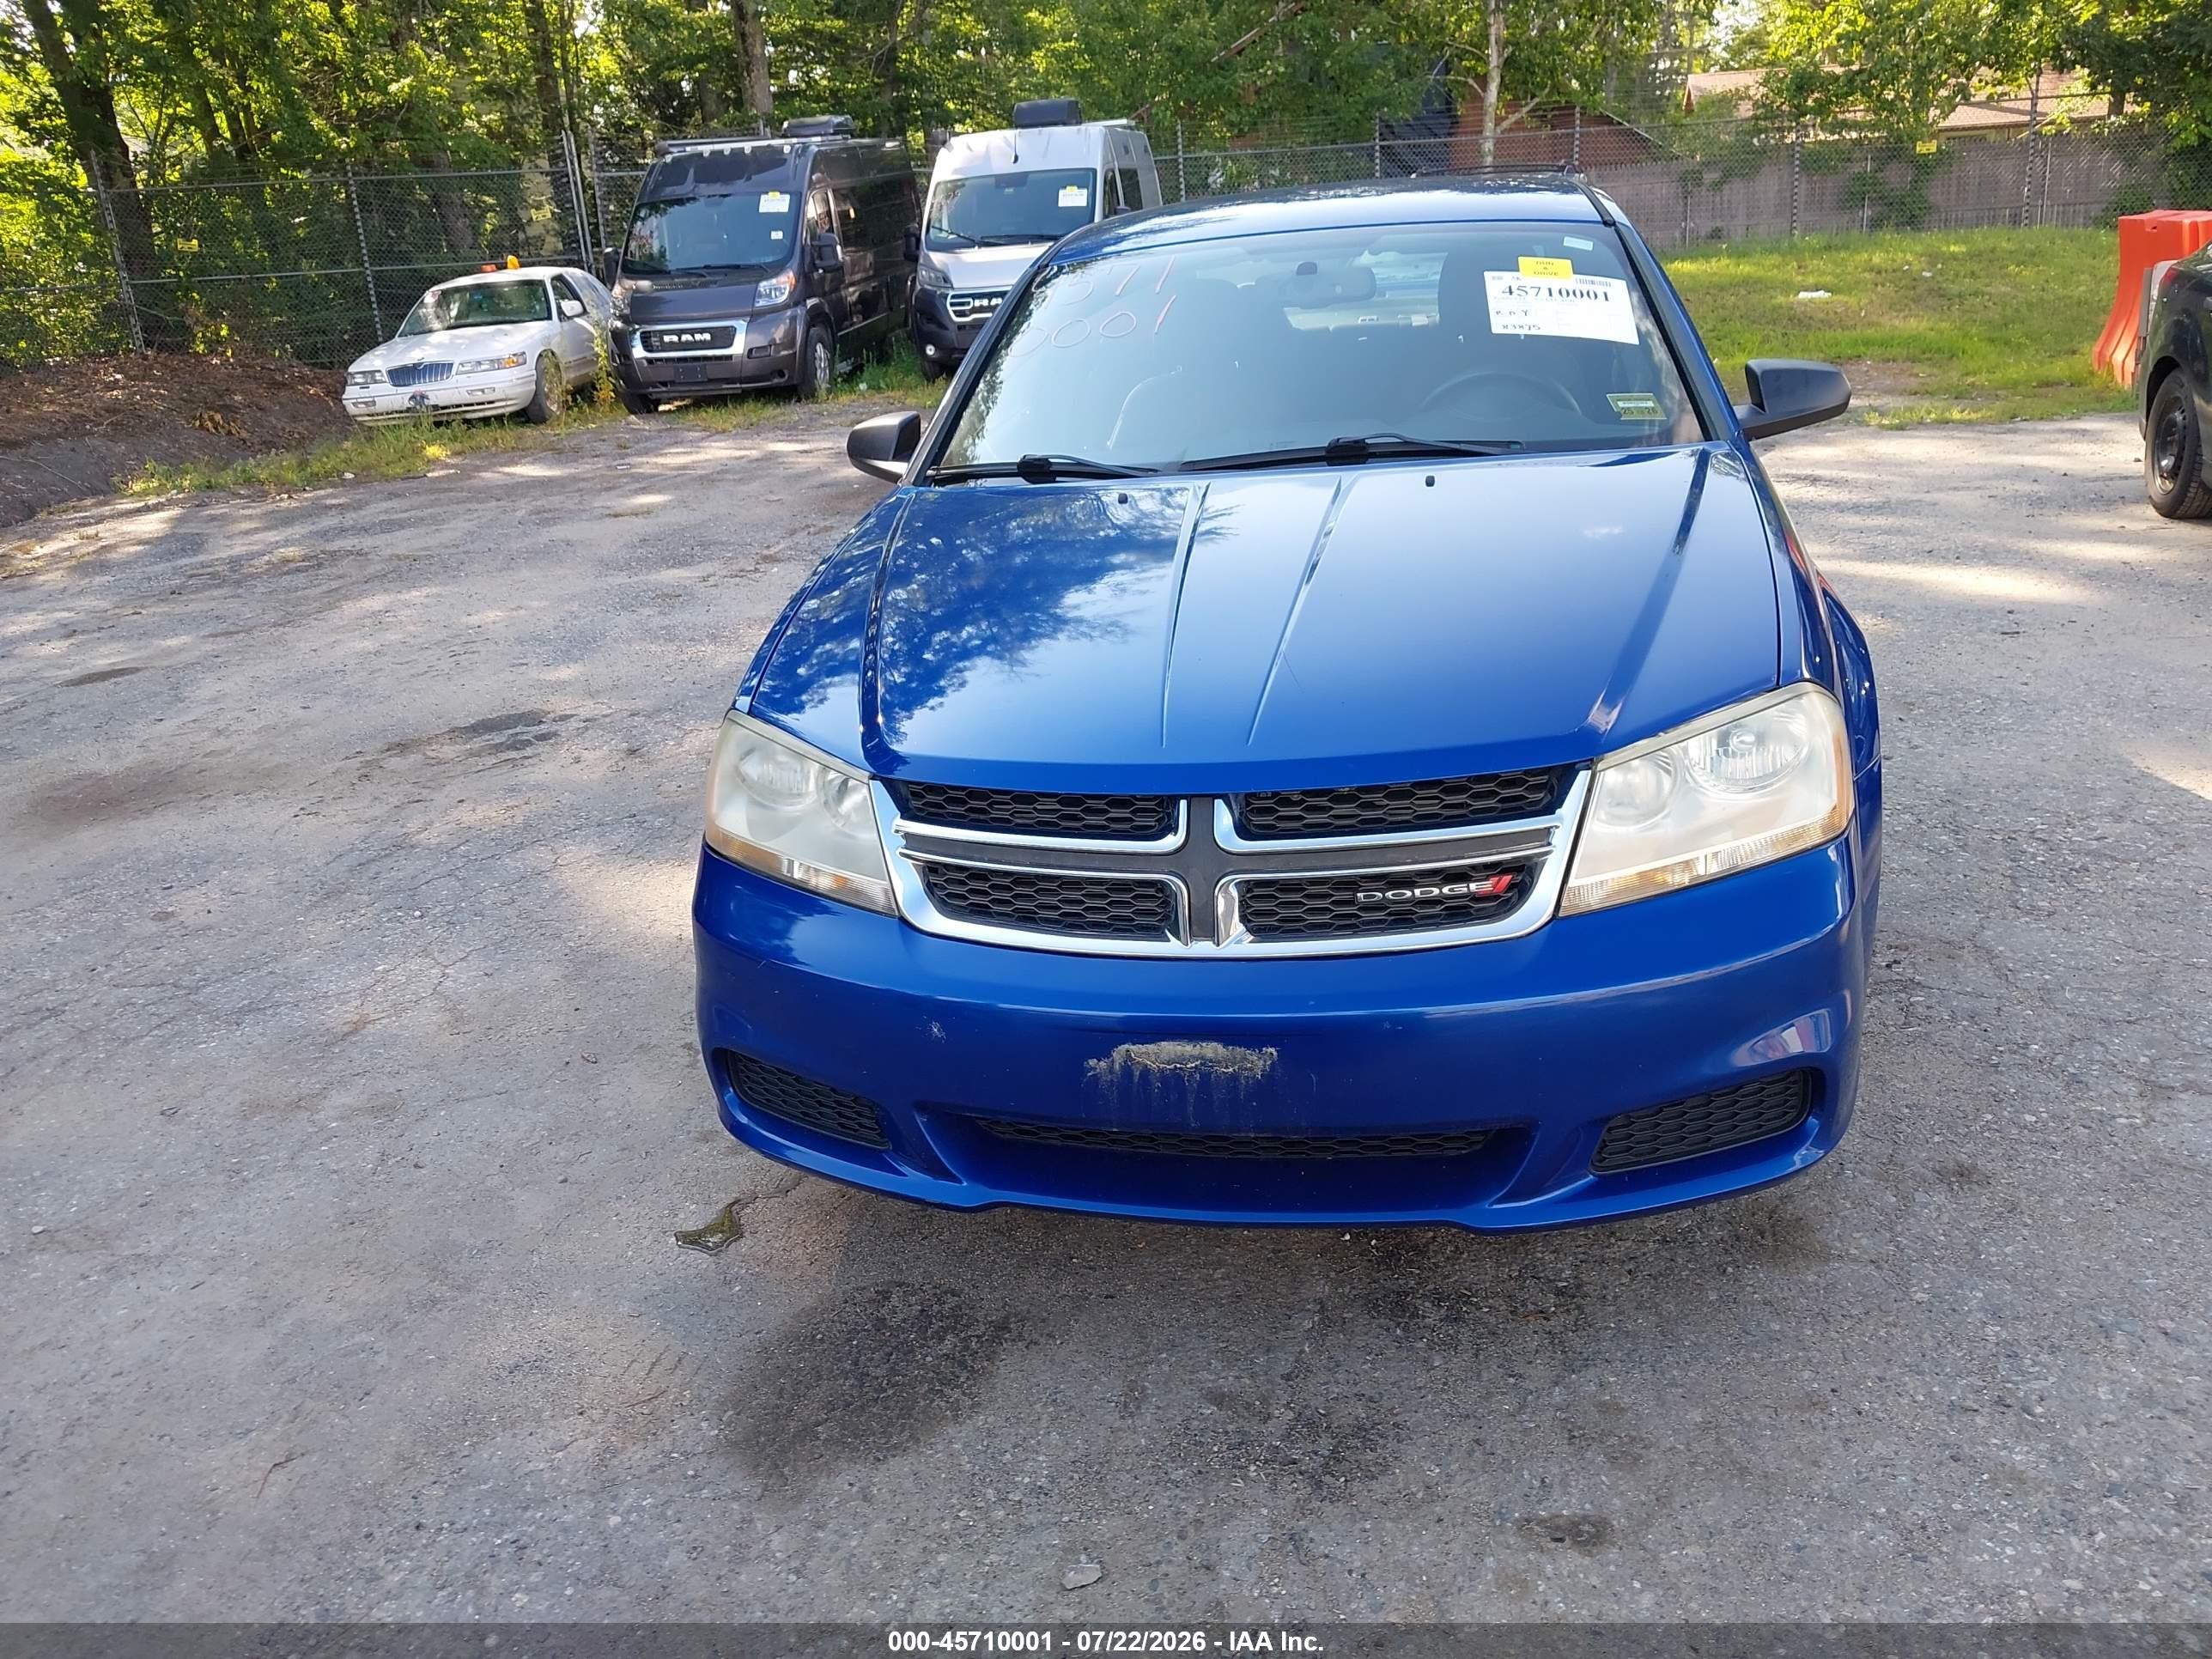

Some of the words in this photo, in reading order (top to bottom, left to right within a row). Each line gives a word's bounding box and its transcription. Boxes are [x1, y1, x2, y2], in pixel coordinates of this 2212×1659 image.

[974, 297, 1003, 307] RA
[1501, 284, 1611, 302] 45710001
[1007, 295, 1178, 357] 0001
[663, 332, 712, 343] RAM
[1357, 880, 1494, 902] DODGE
